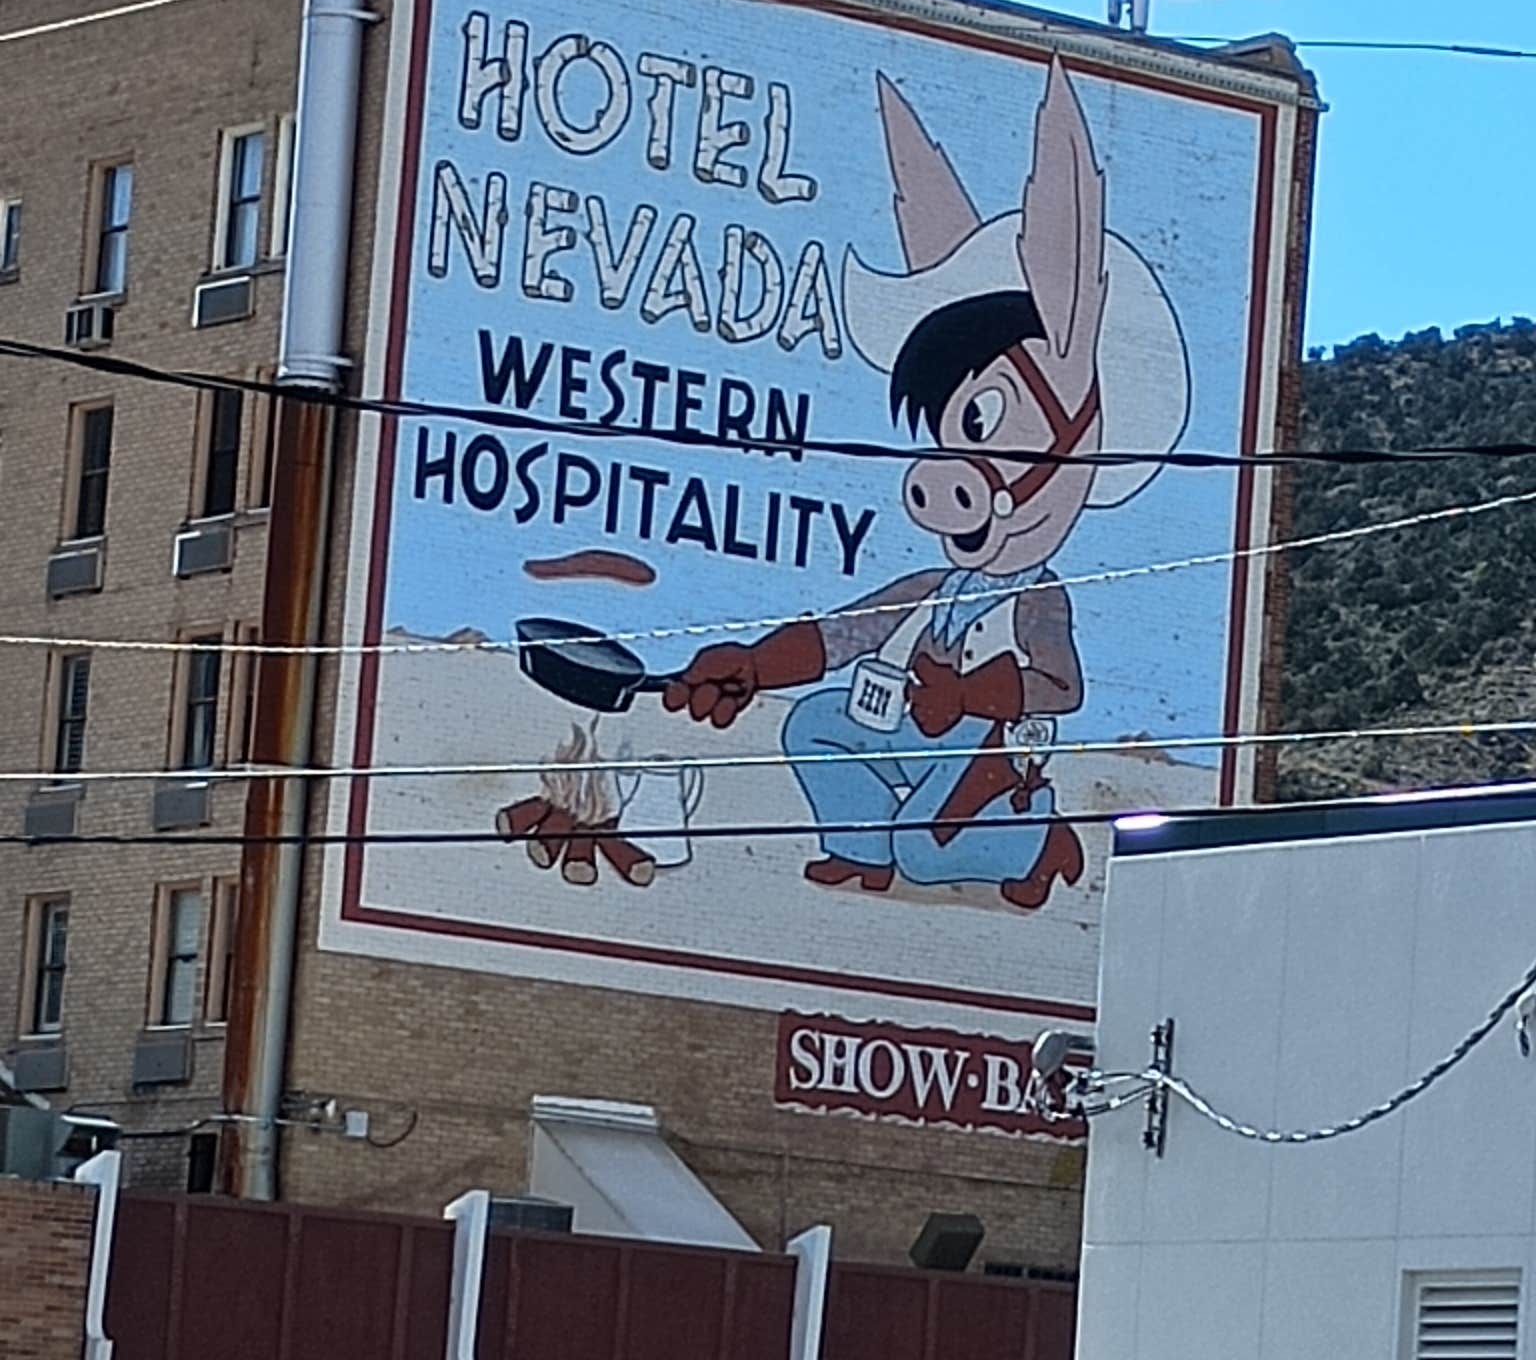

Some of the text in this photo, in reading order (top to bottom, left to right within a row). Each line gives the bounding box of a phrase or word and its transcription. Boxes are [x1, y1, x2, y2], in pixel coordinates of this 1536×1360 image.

[460, 11, 817, 203] HOTEL
[428, 160, 842, 360] NEVADA
[478, 329, 811, 463] WESTERN
[415, 425, 876, 576] HOSPITALITY
